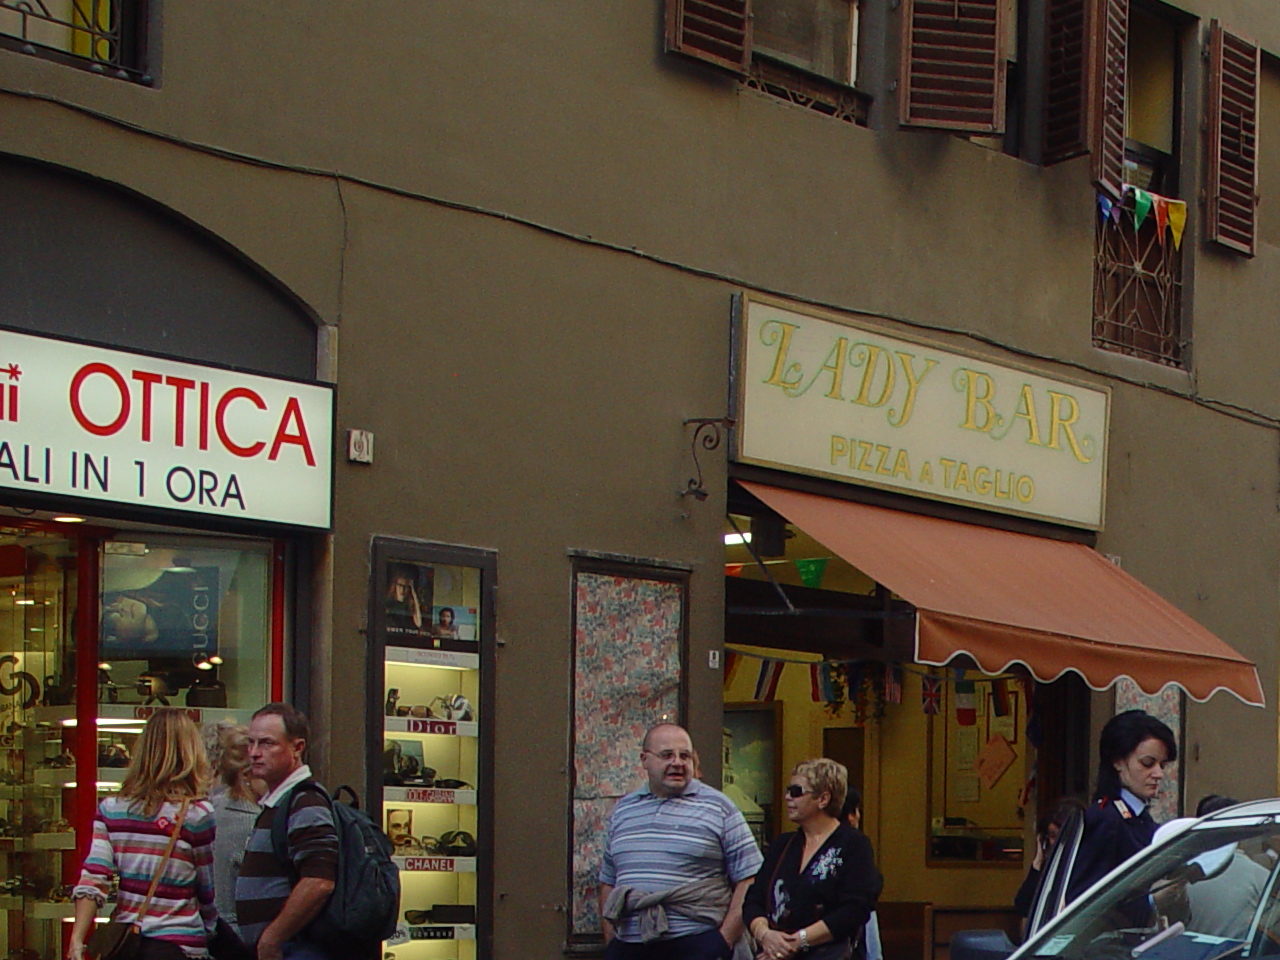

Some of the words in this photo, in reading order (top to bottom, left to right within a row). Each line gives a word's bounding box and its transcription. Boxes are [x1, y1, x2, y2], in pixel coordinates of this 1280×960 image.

[69, 362, 317, 467] OTTICA
[759, 319, 940, 429] LADY
[951, 366, 1095, 464] BAR
[71, 451, 110, 493] IN
[134, 460, 146, 498] 1
[166, 466, 247, 510] ORA
[830, 435, 911, 481] PIZZA
[940, 458, 1035, 504] TAGLIO
[192, 584, 209, 668] GUCCI
[410, 719, 457, 735] Dior
[405, 858, 454, 871] CHANEL
